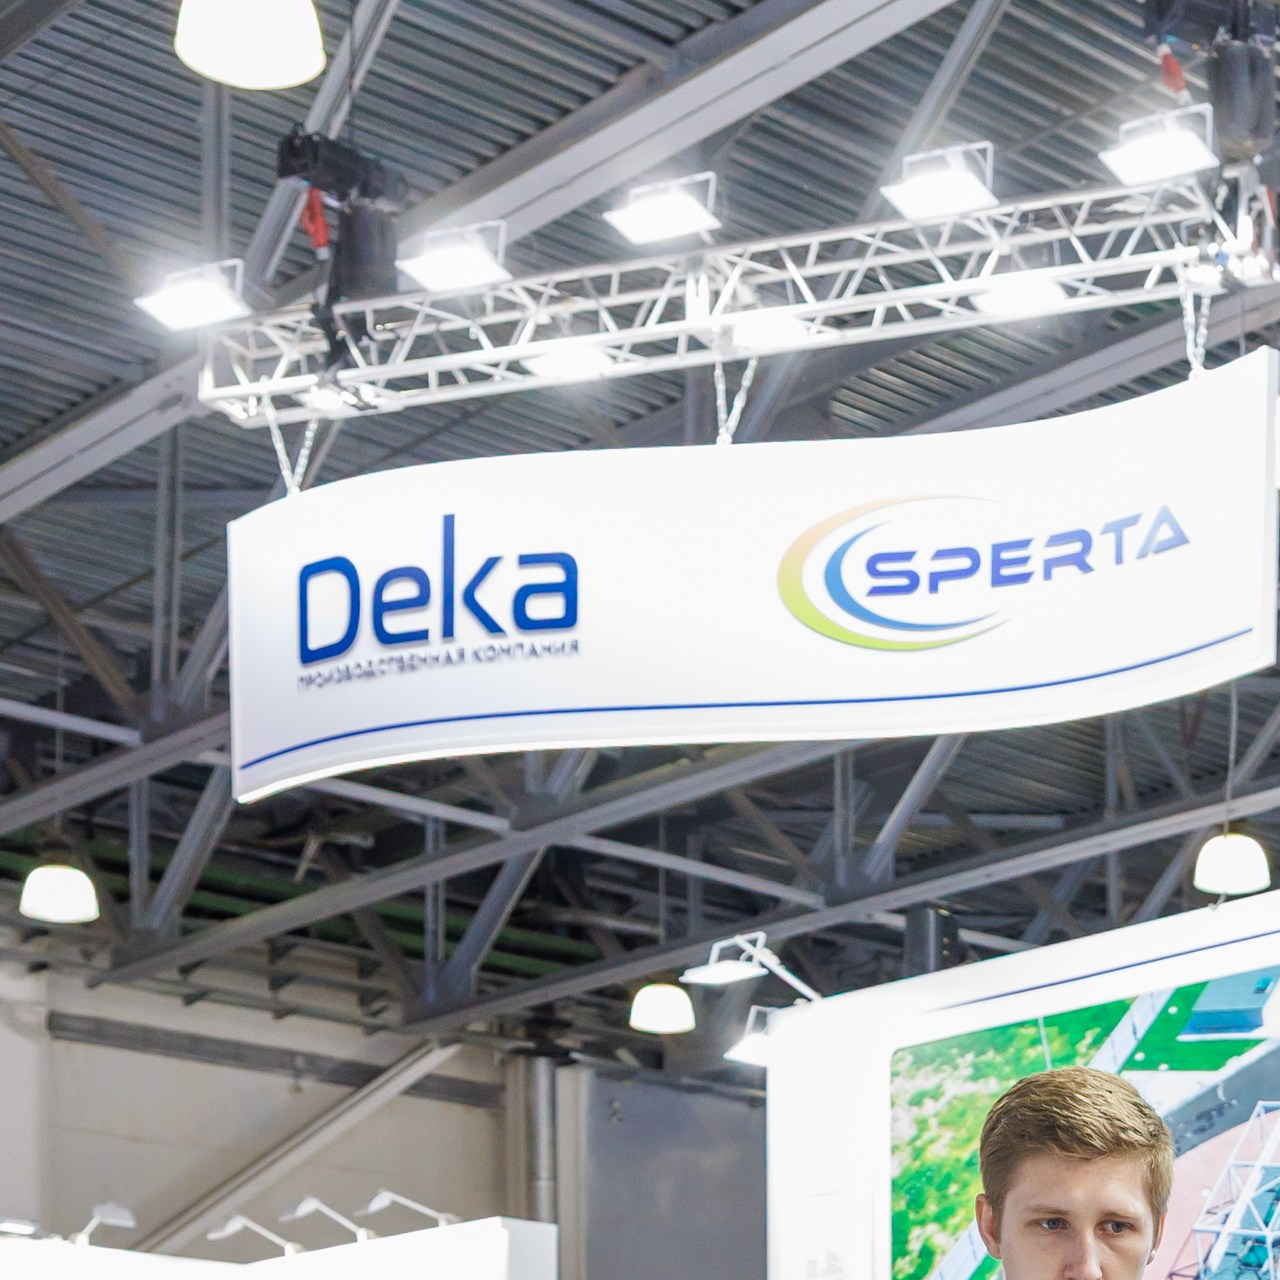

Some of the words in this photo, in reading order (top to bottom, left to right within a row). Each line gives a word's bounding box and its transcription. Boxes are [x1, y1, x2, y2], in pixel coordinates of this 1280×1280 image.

[298, 513, 578, 665] Deka
[865, 504, 1190, 597] SPERTA
[472, 639, 579, 662] КОМПАНИЯ
